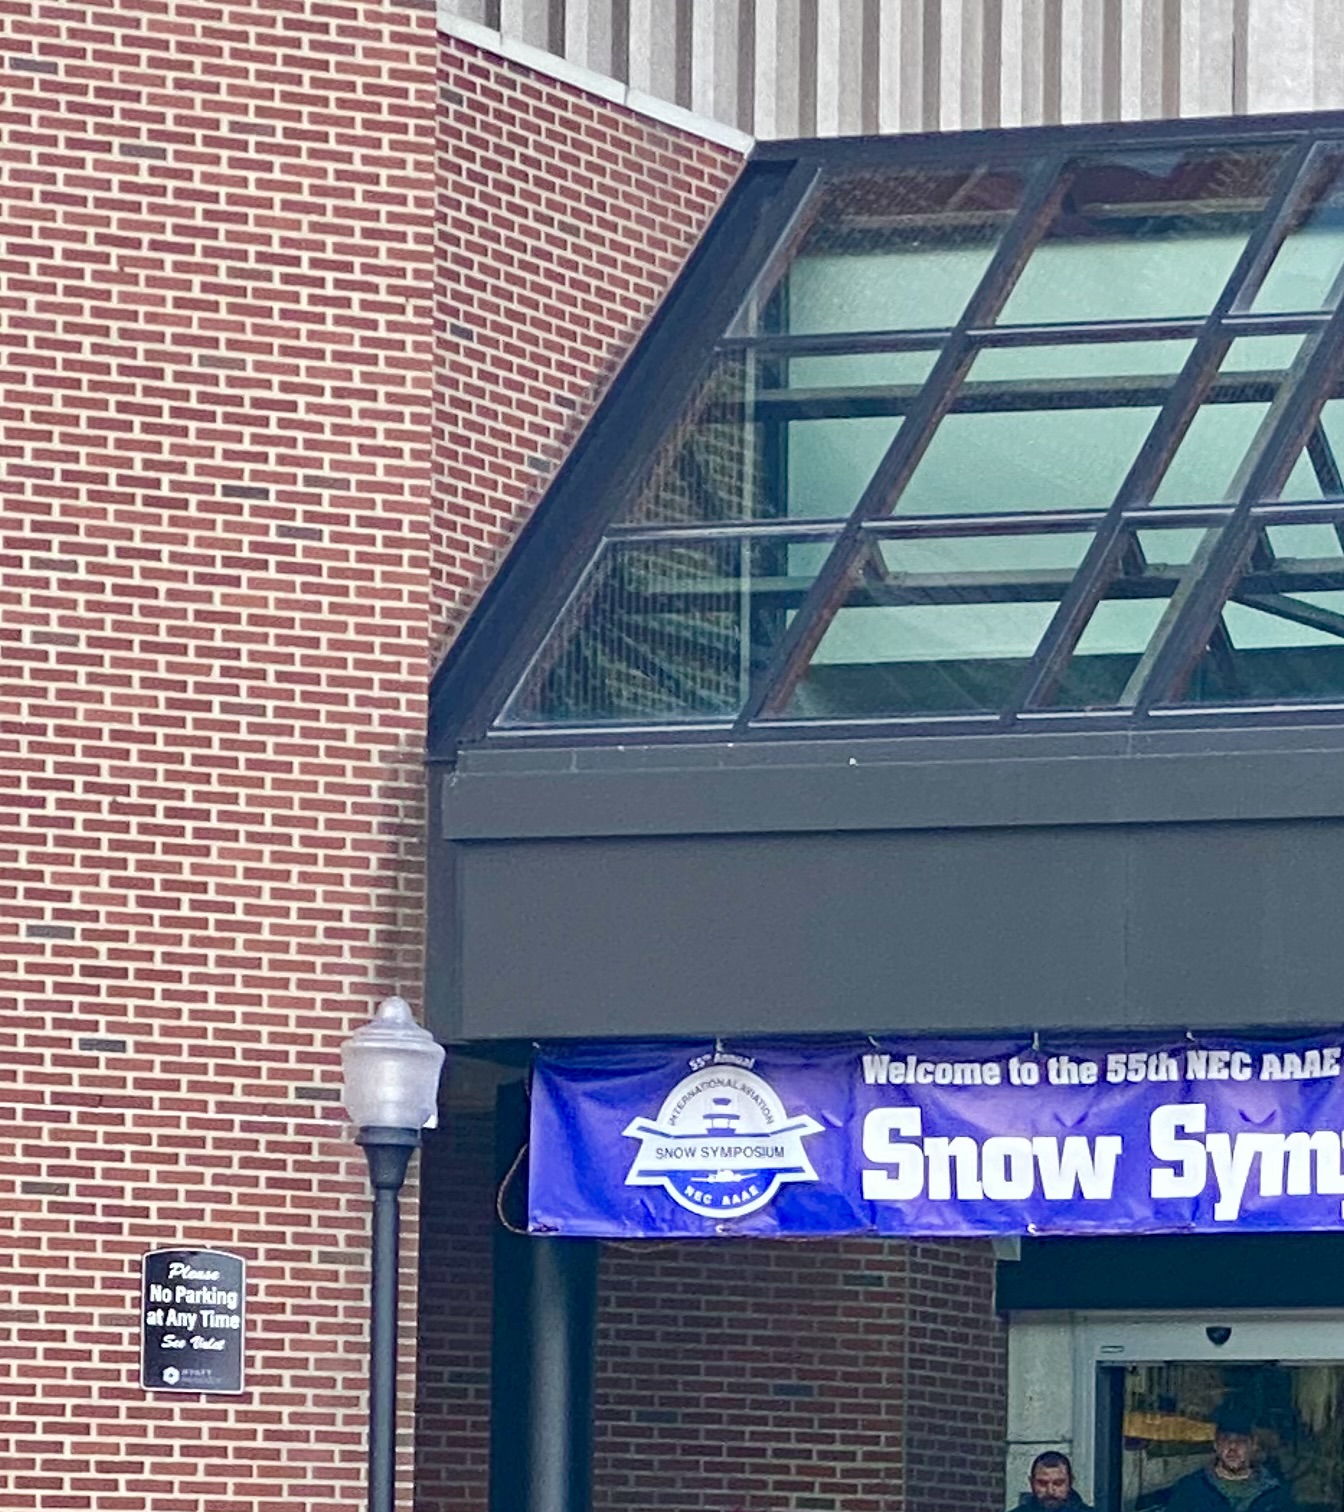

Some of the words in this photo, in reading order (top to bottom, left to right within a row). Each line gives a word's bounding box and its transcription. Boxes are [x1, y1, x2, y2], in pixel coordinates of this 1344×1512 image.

[862, 1054, 1001, 1085] Welcome
[1008, 1056, 1039, 1085] to
[1047, 1056, 1098, 1085] the
[1106, 1051, 1178, 1083] 55th
[1186, 1050, 1252, 1081] NEC
[1260, 1047, 1341, 1081] AAAE
[669, 1078, 738, 1127] INTERNATIONAL
[740, 1083, 775, 1125] AVIATION
[655, 1146, 697, 1160] SNOW
[700, 1146, 785, 1159] SYMPOSIUM
[862, 1106, 1122, 1200] Snow
[684, 1185, 713, 1205] NEC
[722, 1185, 760, 1206] AAAE
[168, 1262, 221, 1281] Please
[150, 1284, 173, 1303] No
[175, 1285, 238, 1310] Parking
[146, 1308, 165, 1327] at
[165, 1308, 198, 1331] Any
[200, 1309, 241, 1330] Time
[161, 1333, 187, 1349] See
